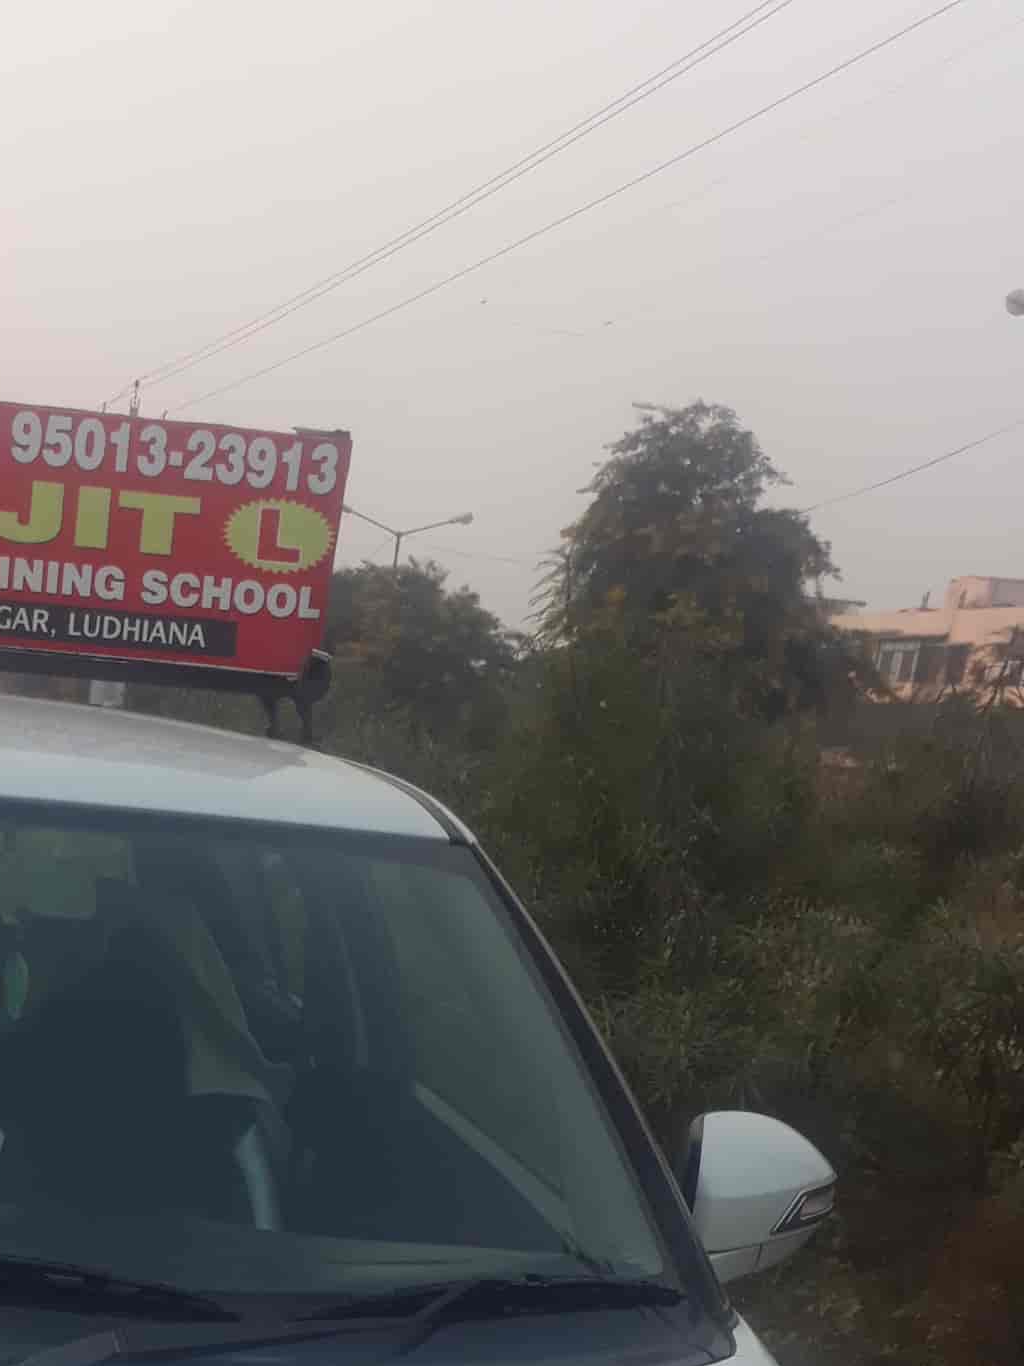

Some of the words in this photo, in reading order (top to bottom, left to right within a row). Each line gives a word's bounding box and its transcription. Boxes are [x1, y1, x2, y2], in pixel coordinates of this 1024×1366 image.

[10, 410, 339, 495] 95013-23913
[256, 504, 301, 564] L
[140, 570, 321, 620] SCHOOL
[68, 611, 206, 649] LUDHIANA
